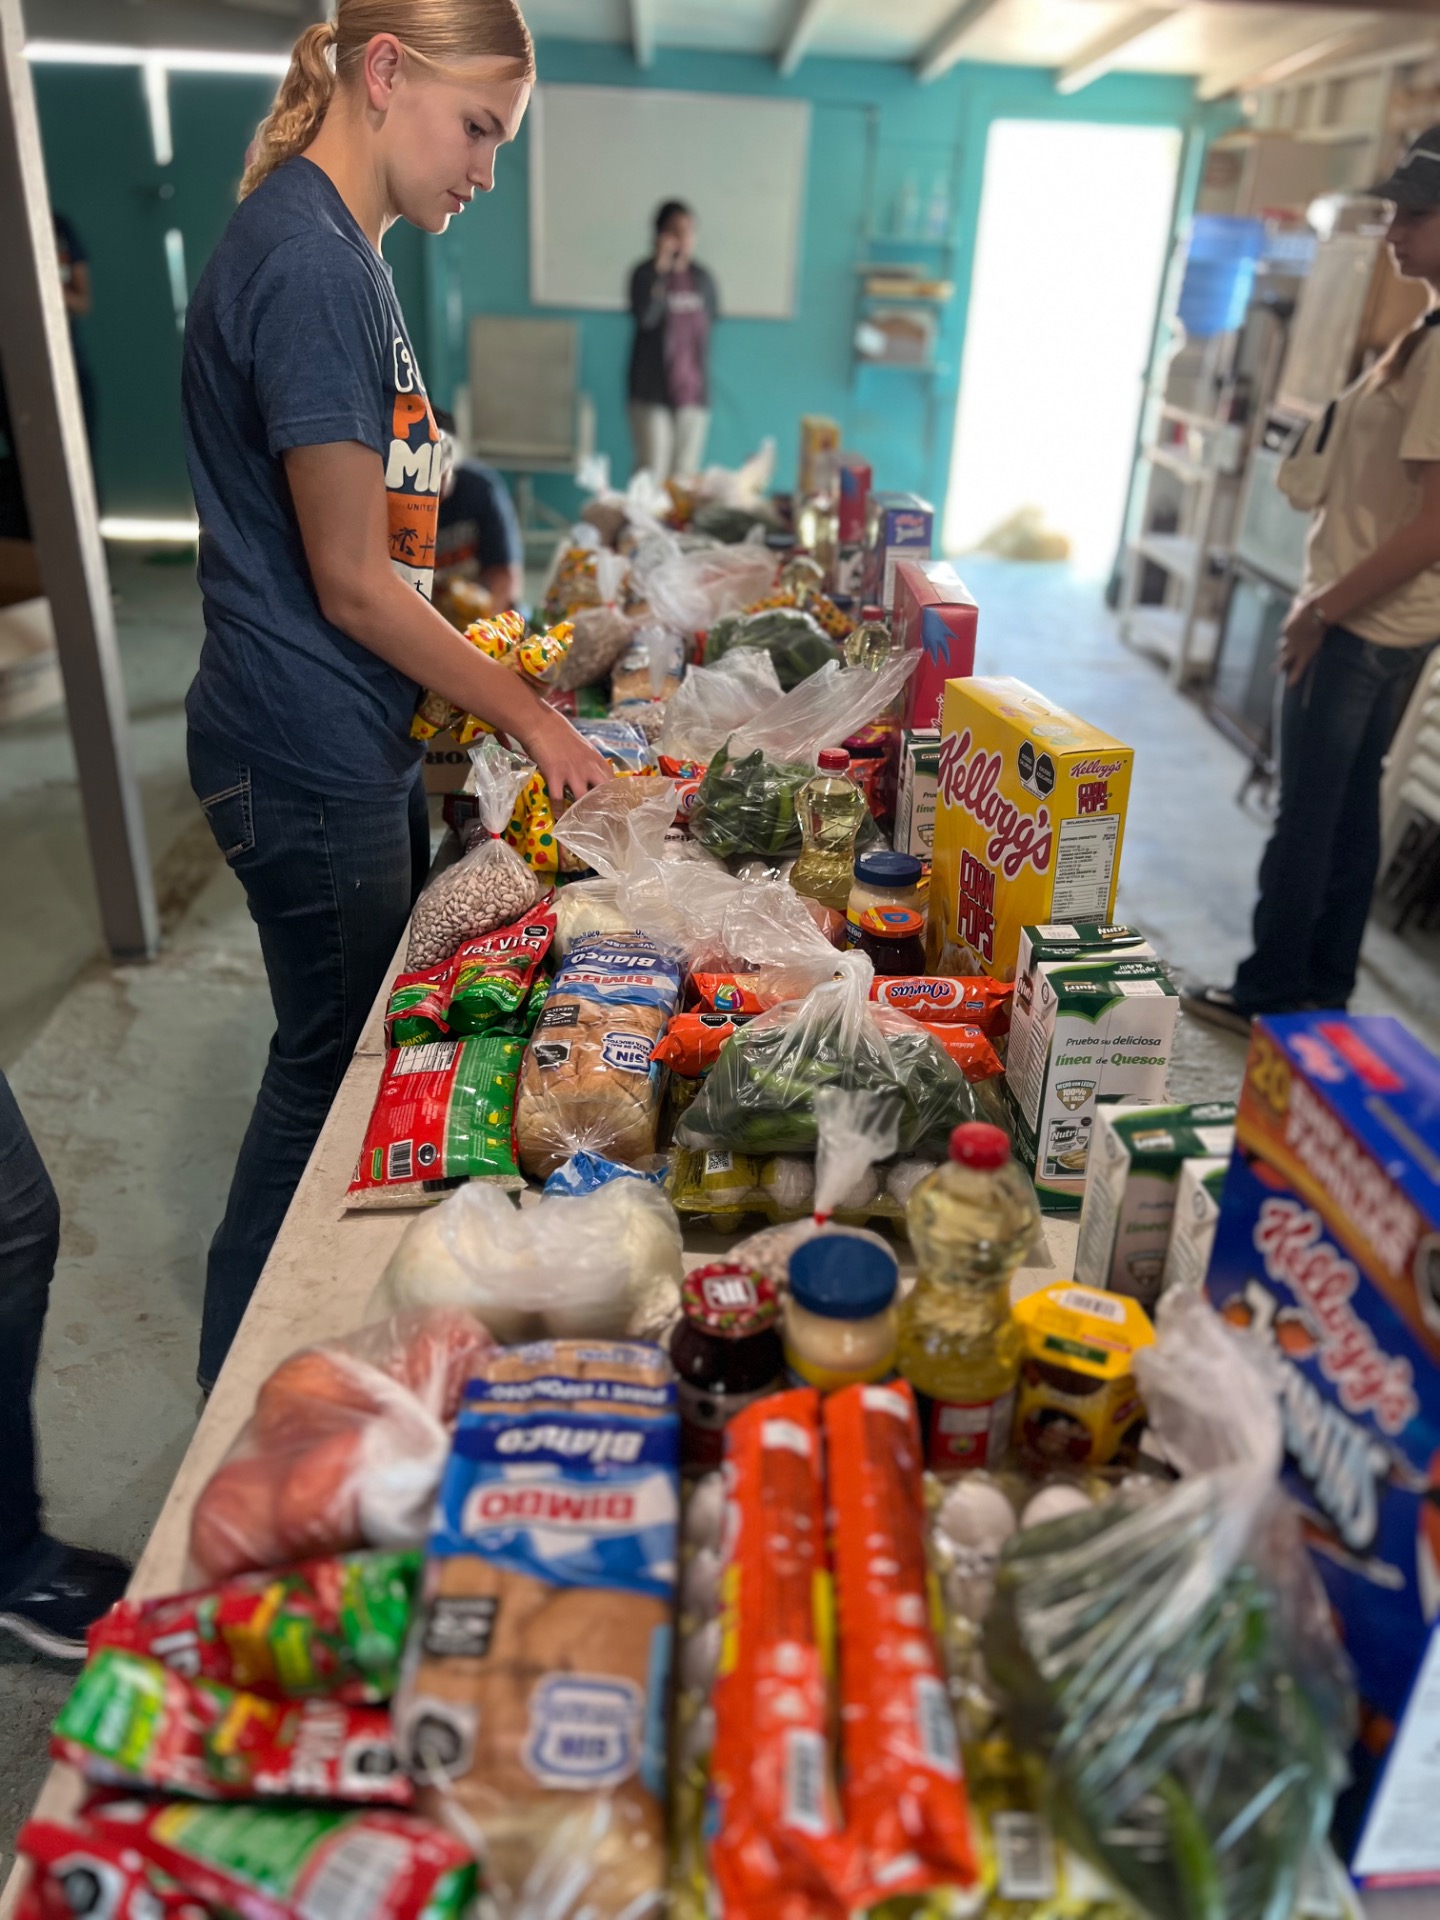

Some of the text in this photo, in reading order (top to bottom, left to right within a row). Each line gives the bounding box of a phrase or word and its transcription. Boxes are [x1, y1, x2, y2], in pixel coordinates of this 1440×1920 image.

[1070, 760, 1121, 778] Kellogg's
[916, 804, 935, 813] líne
[938, 731, 1052, 877] Kellogg's
[960, 850, 995, 913] CORN
[957, 891, 994, 963] POPS
[571, 952, 657, 967] Blanco
[1065, 1037, 1099, 1047] Prueba
[1112, 1036, 1162, 1046] deliciosa
[616, 1050, 645, 1064] SIN
[1055, 1053, 1166, 1067] línea de Quesos
[1063, 1088, 1087, 1096] 100%
[1050, 1129, 1079, 1140] Nutri
[1256, 1200, 1417, 1433] Kellogg's
[495, 1424, 645, 1464] Blanco
